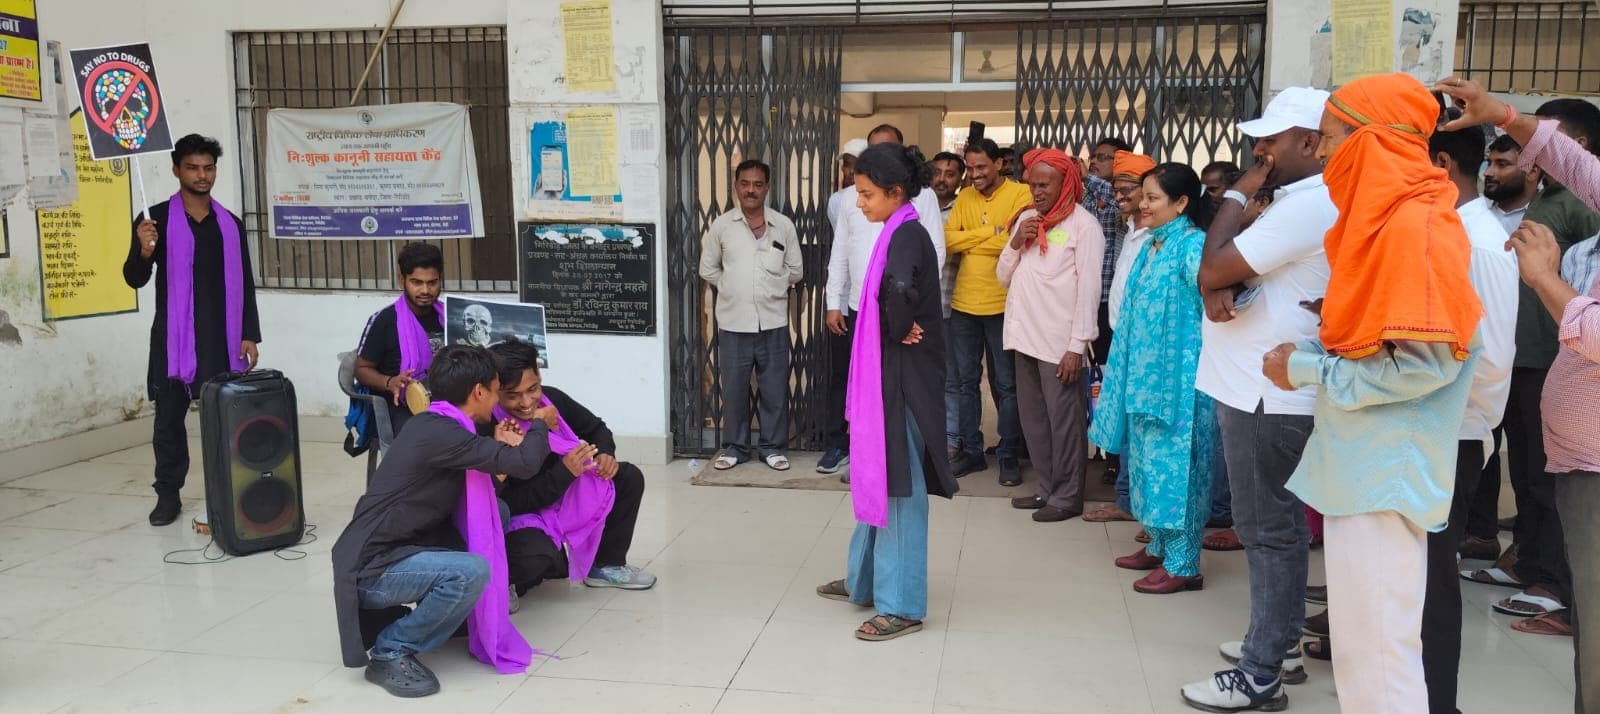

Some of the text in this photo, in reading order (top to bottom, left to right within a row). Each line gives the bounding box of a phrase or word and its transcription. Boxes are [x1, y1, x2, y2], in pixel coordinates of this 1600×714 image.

[81, 52, 151, 77] SAY NO TO DRUGS
[305, 129, 332, 141] राष्ट्रीय
[333, 149, 370, 167] कानूनी
[374, 151, 418, 162] सहायता
[559, 262, 574, 272] शुभ
[581, 278, 592, 291] श्री
[593, 280, 622, 293] नागेन्द्र
[624, 280, 649, 293] महतो
[611, 301, 632, 312] कुमार
[633, 302, 649, 311] राय
